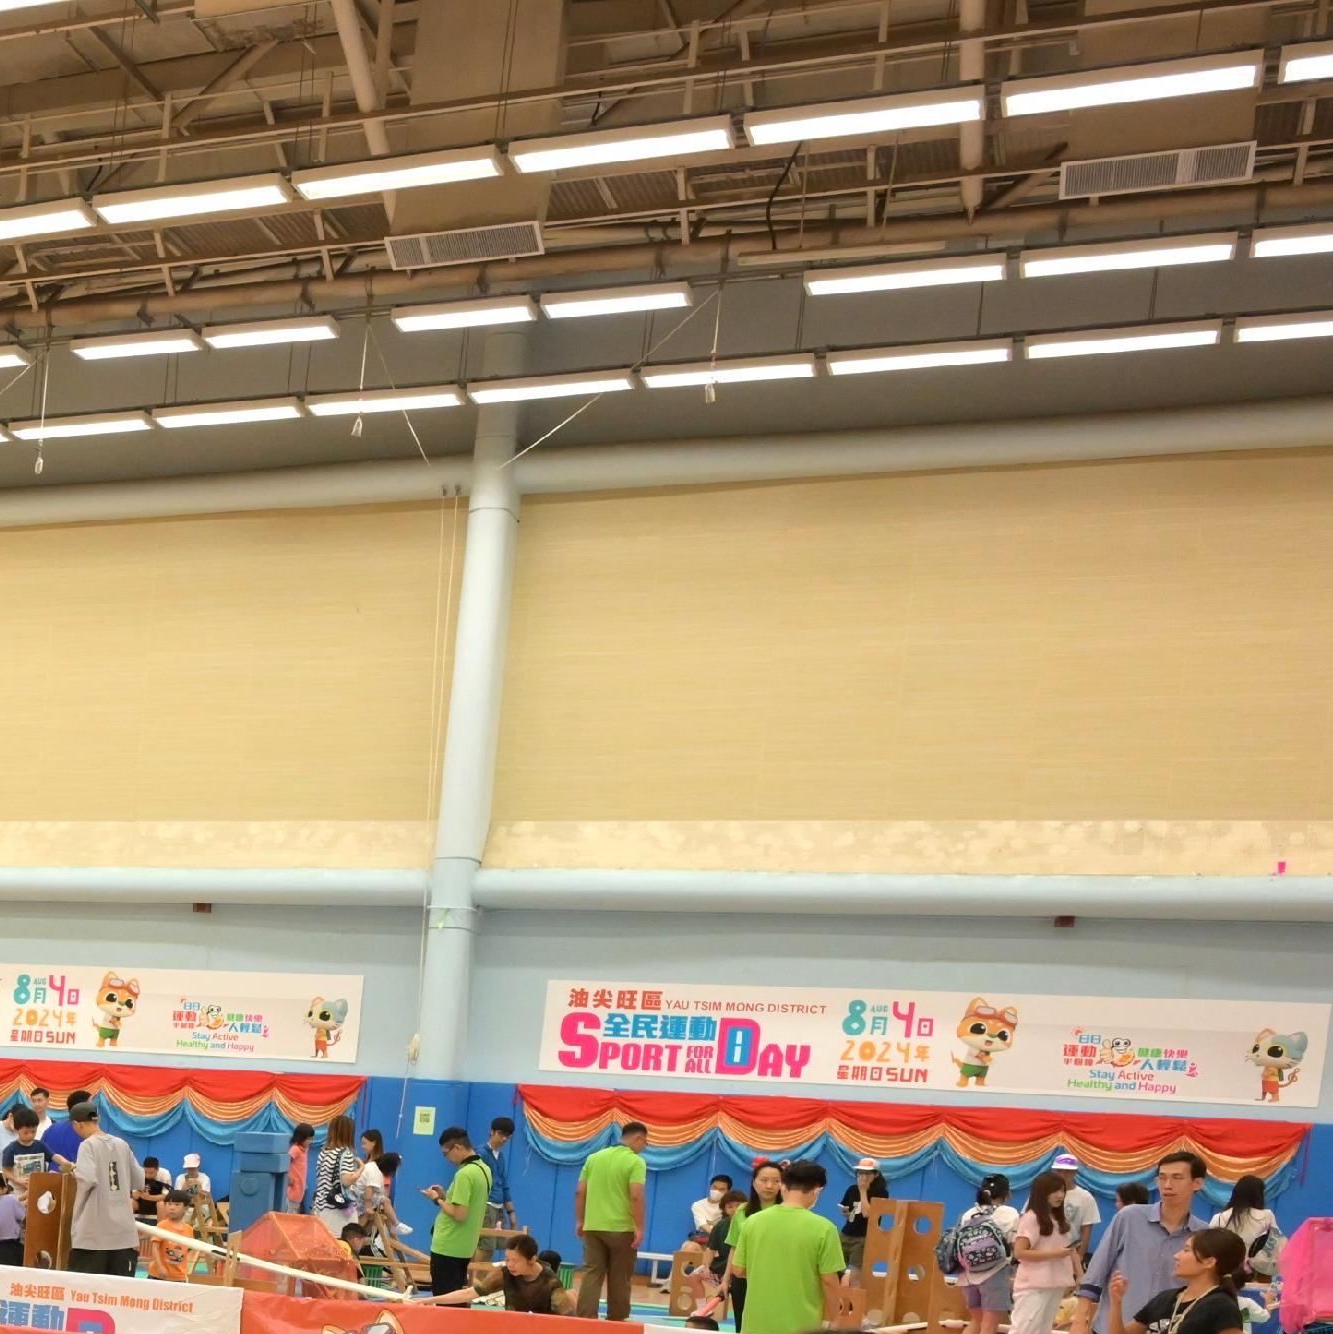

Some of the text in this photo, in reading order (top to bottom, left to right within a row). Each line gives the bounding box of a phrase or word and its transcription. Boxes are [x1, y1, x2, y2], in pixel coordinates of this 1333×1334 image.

[568, 988, 827, 1015] 油尖旺區 YAU TSIM MONG DISTRICT
[12, 1009, 77, 1028] 2024年
[603, 1013, 717, 1042] 全民運動
[46, 1033, 76, 1044] SUN
[192, 1032, 238, 1041] Stay Active
[558, 1012, 811, 1078] SPORT FOR ALL DAY
[177, 1039, 254, 1052] Healthy and Happy
[840, 1040, 930, 1063] 2024年
[886, 1068, 928, 1083] SUN
[1089, 1069, 1154, 1081] Stay Active
[1068, 1079, 1176, 1094] Healthy and Happy
[10, 1282, 194, 1313] 油尖旺區 Yau Tsim Mong District
